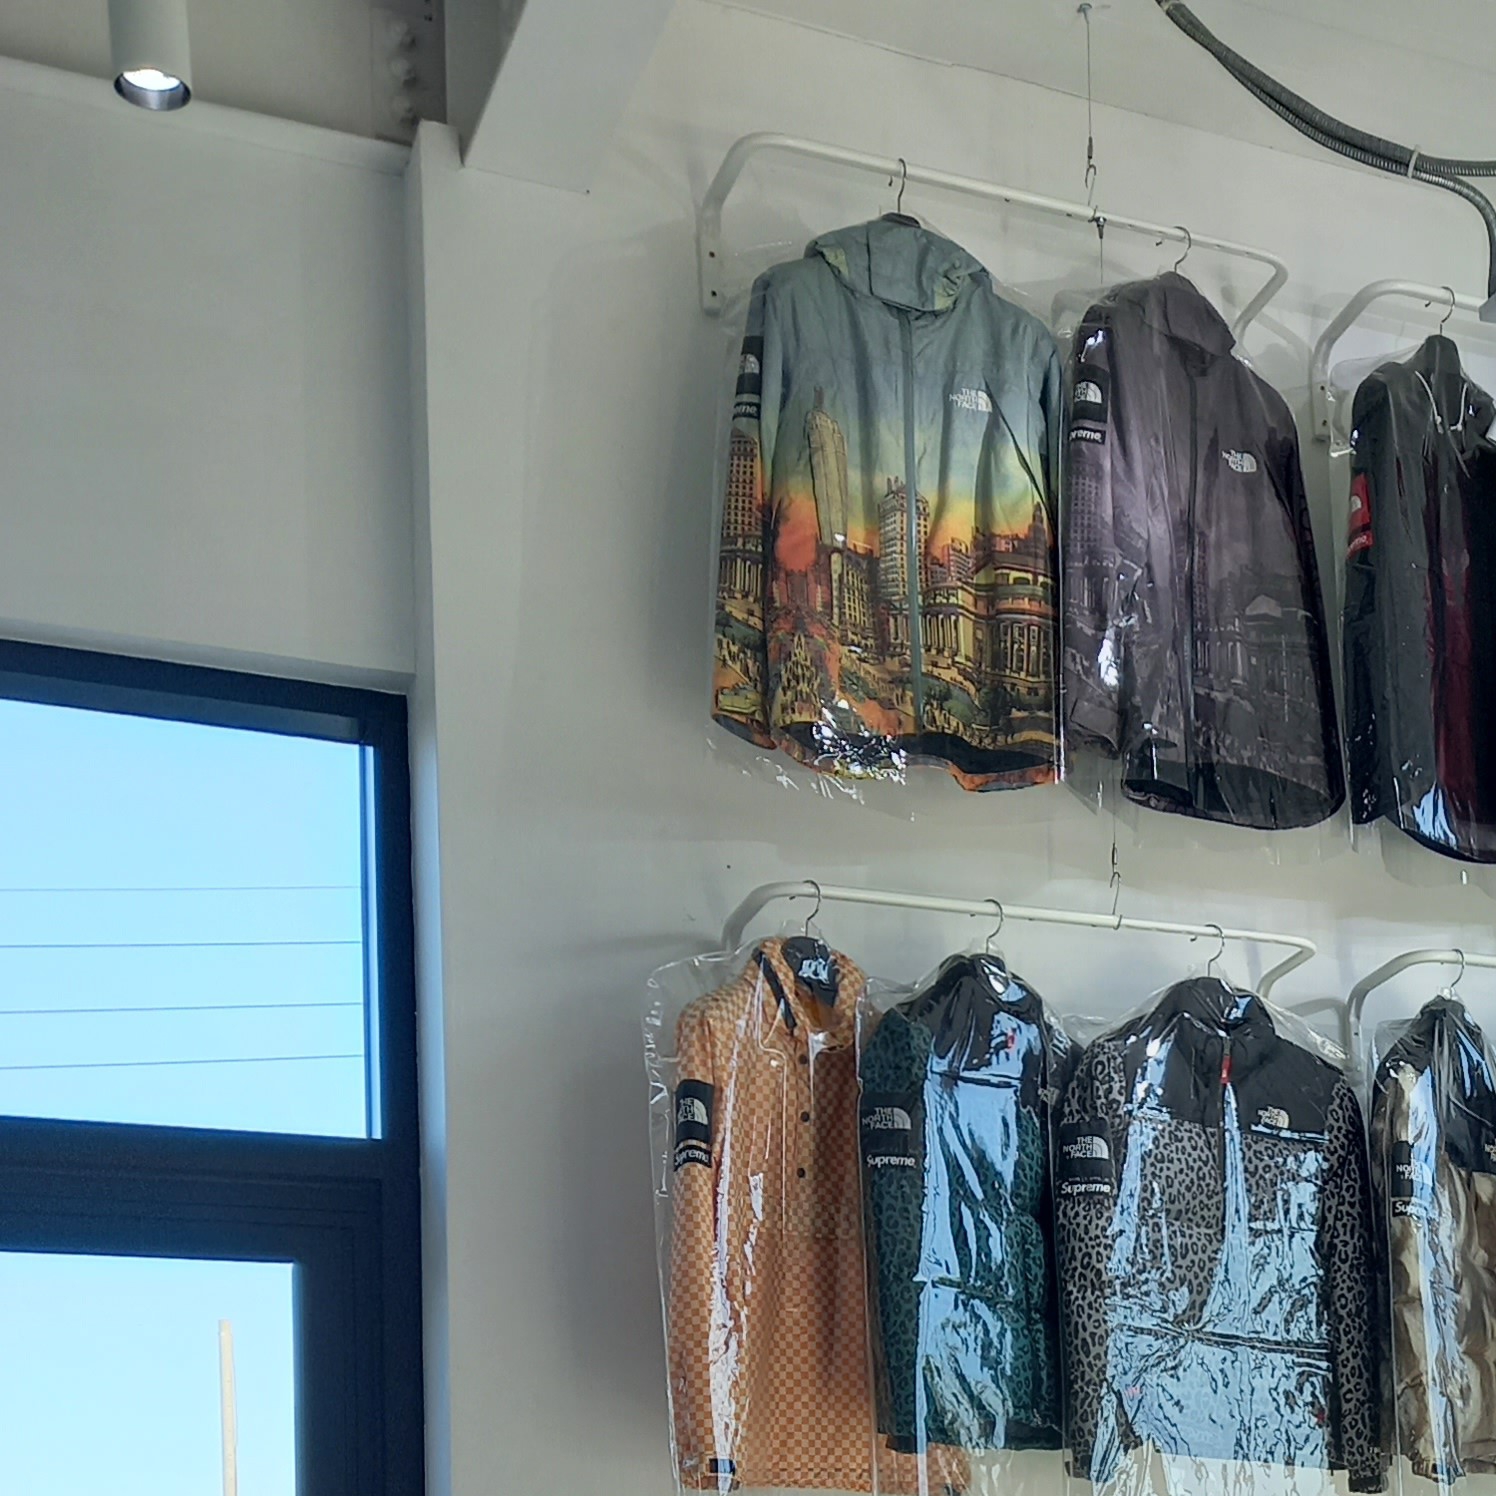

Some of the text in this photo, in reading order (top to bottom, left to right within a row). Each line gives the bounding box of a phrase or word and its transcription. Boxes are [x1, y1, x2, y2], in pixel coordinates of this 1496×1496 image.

[1077, 1136, 1093, 1144] THE
[1071, 1150, 1093, 1158] FACE
[867, 1154, 916, 1169] Supreme
[1061, 1181, 1112, 1196] Supreme
